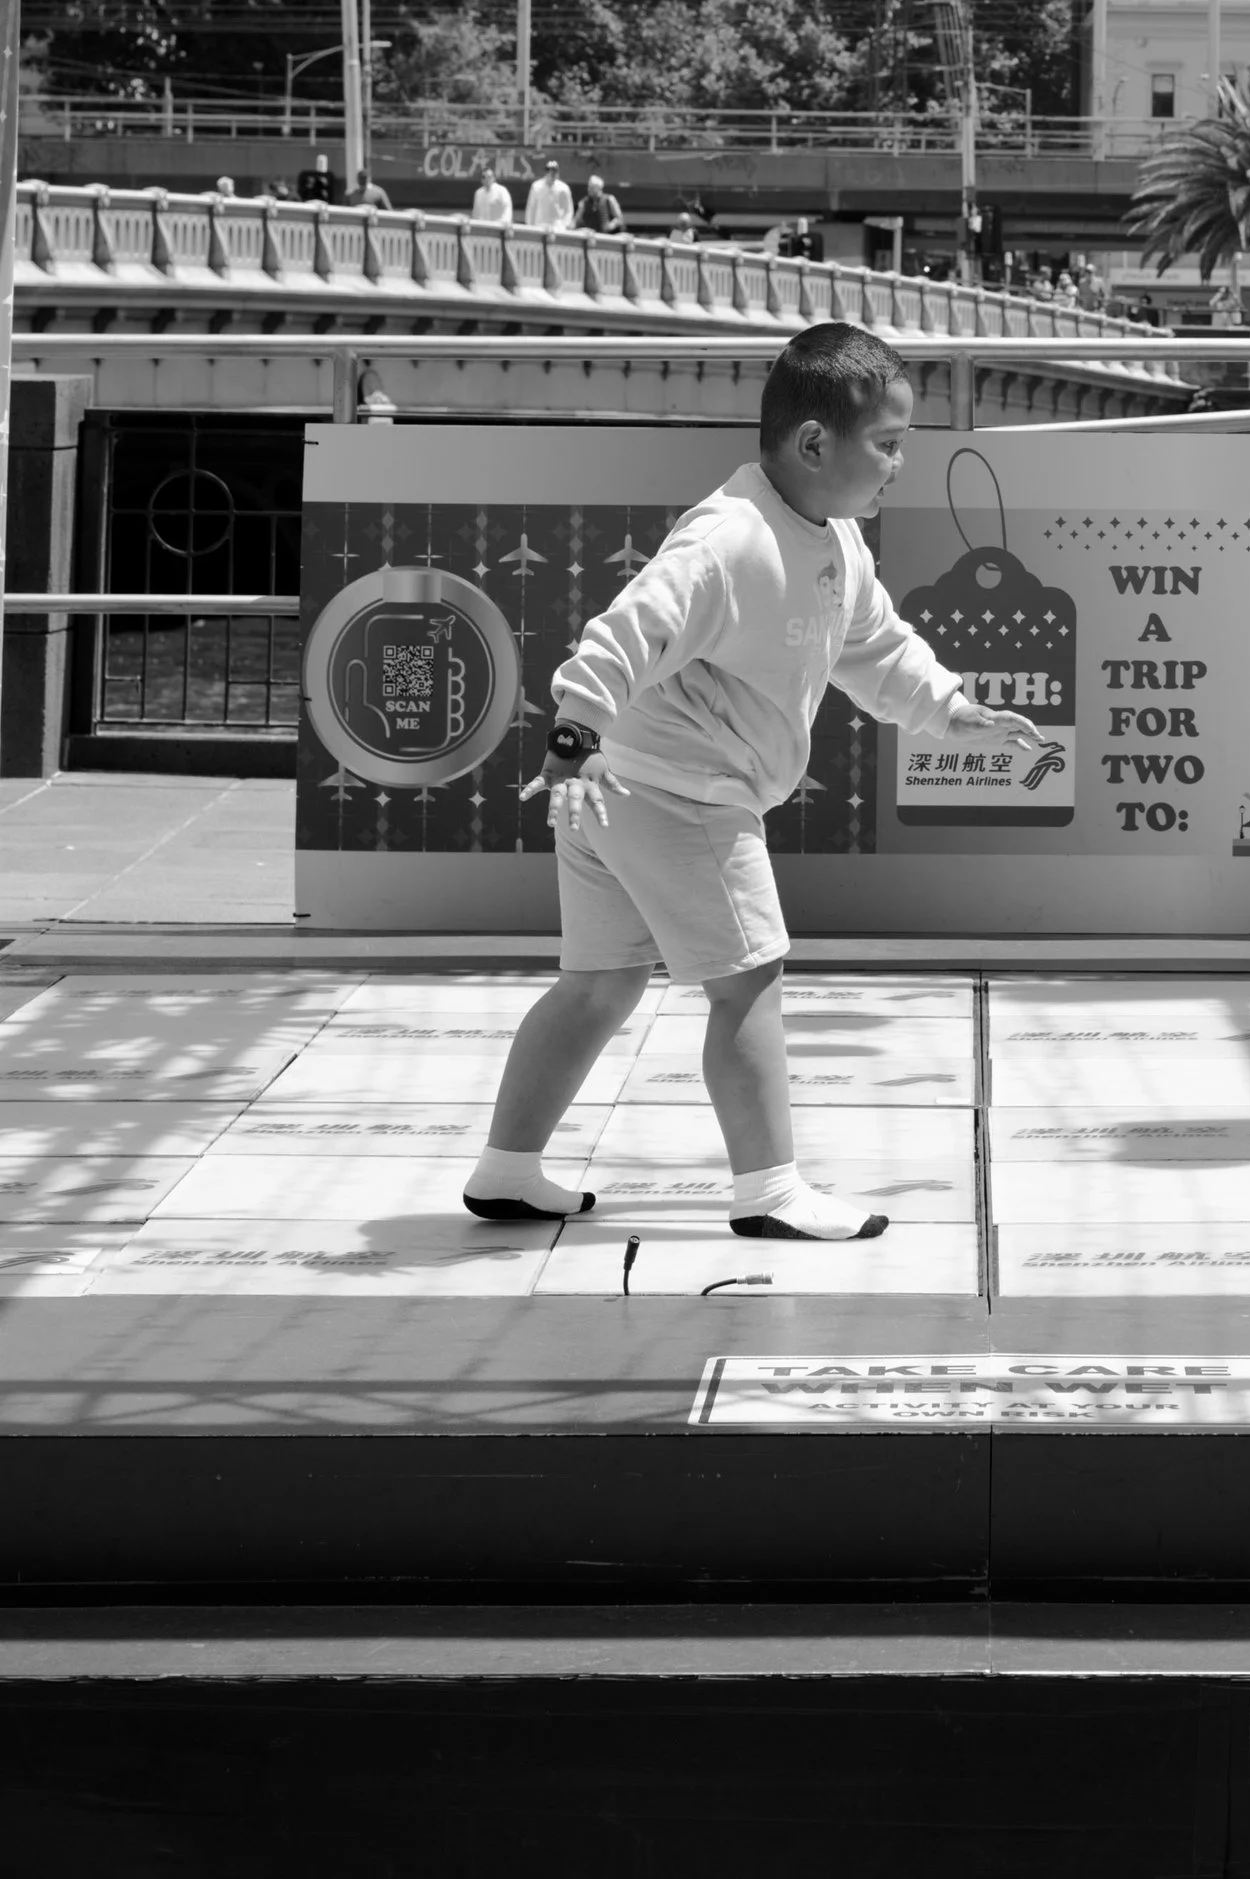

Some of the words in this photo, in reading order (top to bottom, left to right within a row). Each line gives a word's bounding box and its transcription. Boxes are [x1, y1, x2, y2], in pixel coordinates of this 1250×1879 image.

[1109, 565, 1202, 596] WIN
[1137, 612, 1172, 642] A
[956, 671, 1063, 706] ITH:
[1101, 660, 1208, 690] TRIP
[385, 700, 431, 713] SCAN
[396, 718, 420, 730] ME
[1109, 707, 1199, 737] FOR
[907, 752, 1014, 773] 深圳航空
[1101, 754, 1205, 785] TWO
[905, 775, 963, 787] Shenzhen
[966, 776, 1012, 787] Airlines
[1116, 802, 1189, 832] TO:
[758, 1365, 977, 1377] TAKE
[1008, 1365, 1232, 1377] CARE
[760, 1382, 1015, 1394] WHEN
[1044, 1382, 1228, 1395] WET
